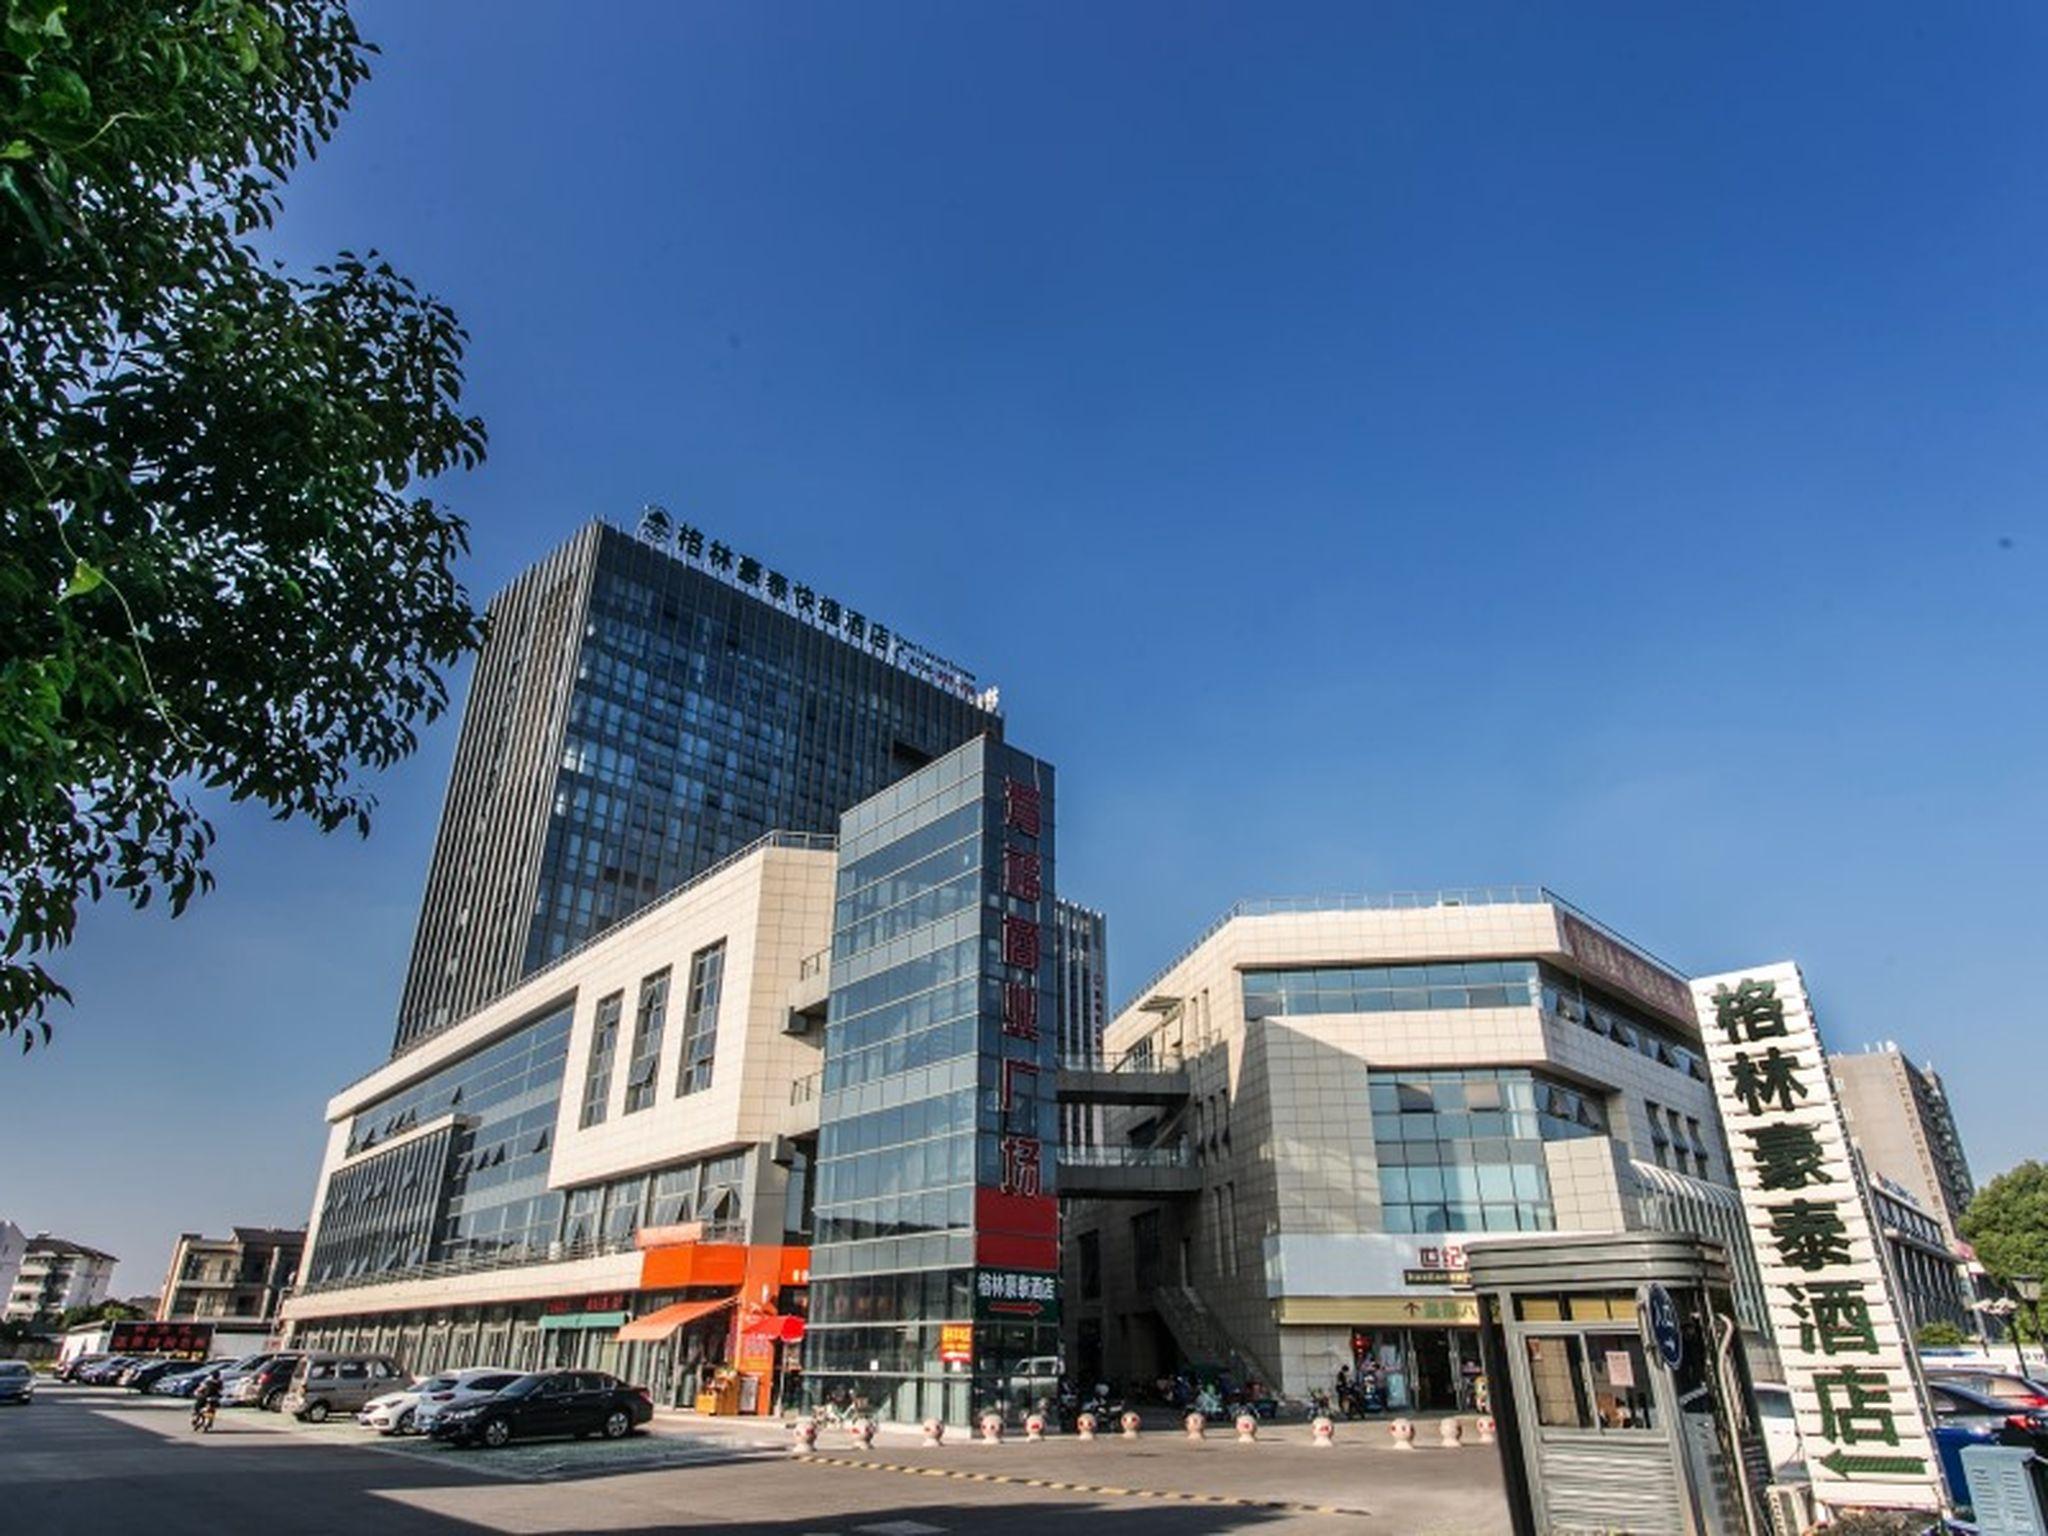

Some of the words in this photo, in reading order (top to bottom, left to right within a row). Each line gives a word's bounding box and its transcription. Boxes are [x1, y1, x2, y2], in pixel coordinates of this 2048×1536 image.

[677, 522, 890, 651] 格林豪泰快捷酒店
[1712, 977, 1901, 1447] 格林豪泰酒店
[977, 1271, 1055, 1300] 格林豪泰酒店
